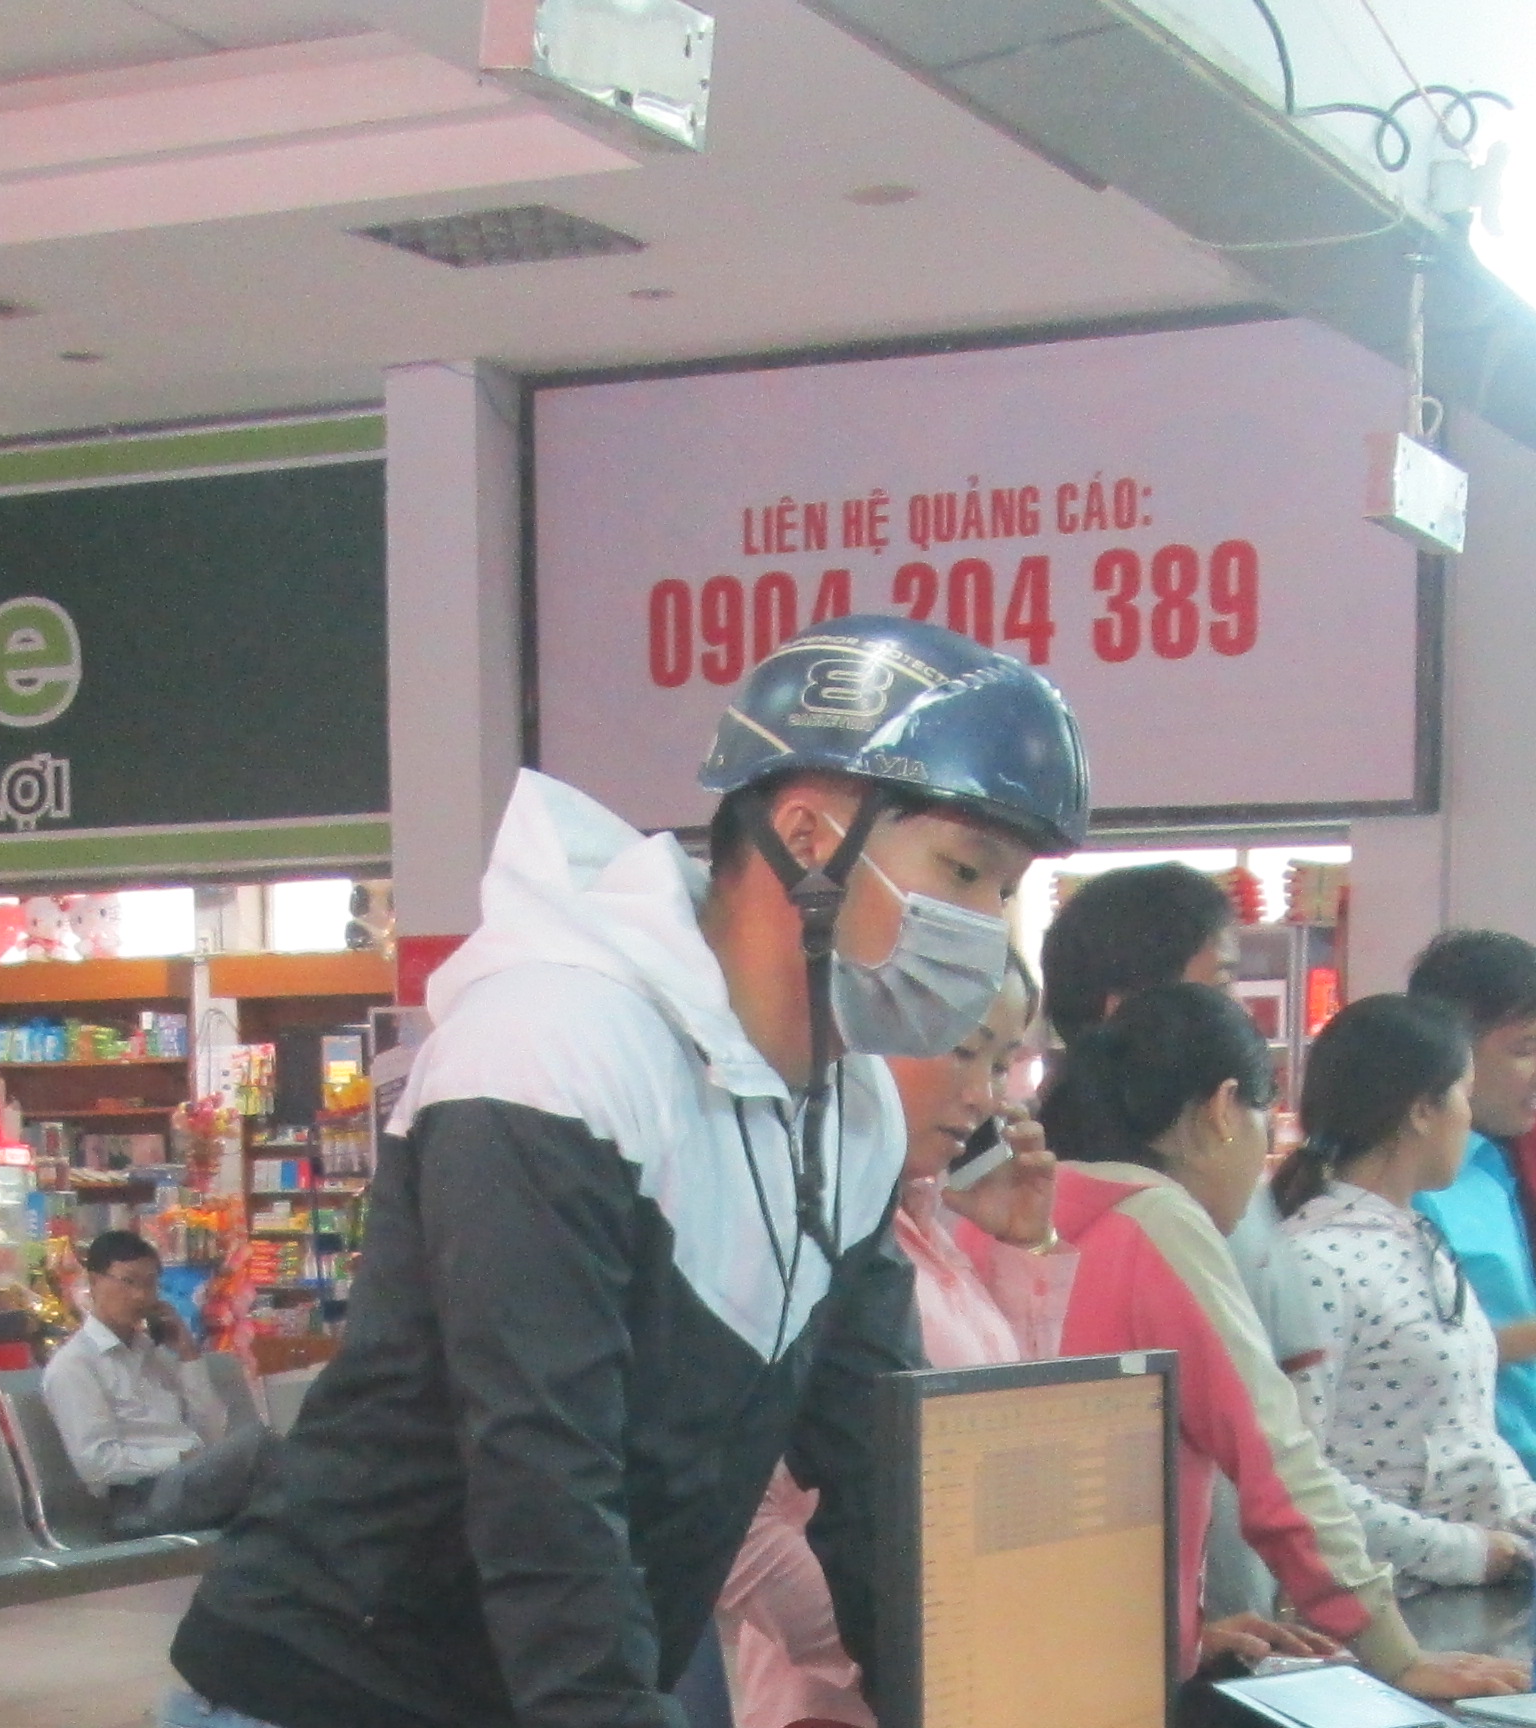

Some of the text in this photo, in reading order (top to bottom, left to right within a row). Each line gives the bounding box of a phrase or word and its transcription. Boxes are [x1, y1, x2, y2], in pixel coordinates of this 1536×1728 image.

[743, 471, 1153, 556] LIÊN HỆ QUẢNG CÁO:
[1092, 538, 1259, 663] 389
